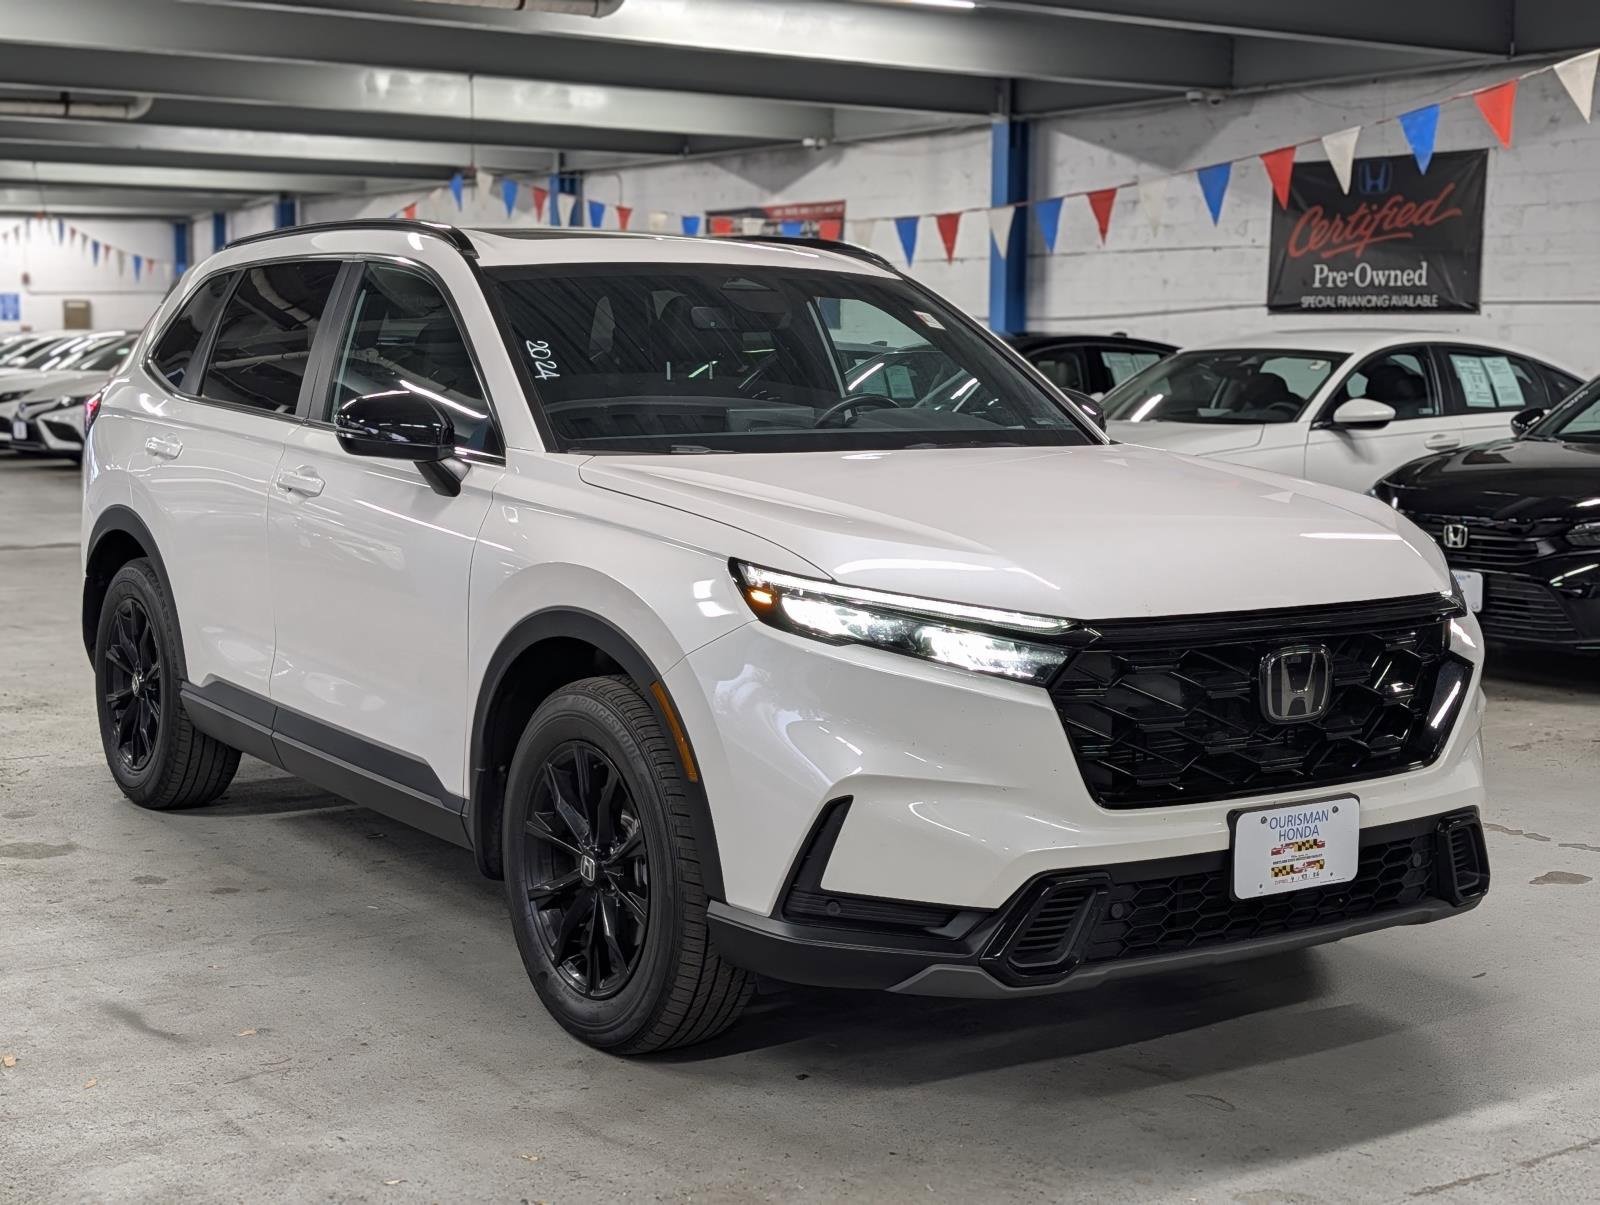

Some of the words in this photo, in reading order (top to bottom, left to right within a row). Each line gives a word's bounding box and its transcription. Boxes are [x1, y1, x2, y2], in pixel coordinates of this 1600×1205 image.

[1288, 182, 1462, 258] Certified
[1312, 261, 1428, 288] Pre-Owned
[1301, 294, 1337, 308] SPECIAL
[1337, 294, 1390, 308] FINANCING
[1390, 293, 1440, 308] AVAILABLE
[525, 340, 561, 380] 2024
[573, 694, 642, 763] BRIDGESTONE
[1269, 809, 1329, 830] OURISMAN
[1278, 825, 1320, 842] HONDA
